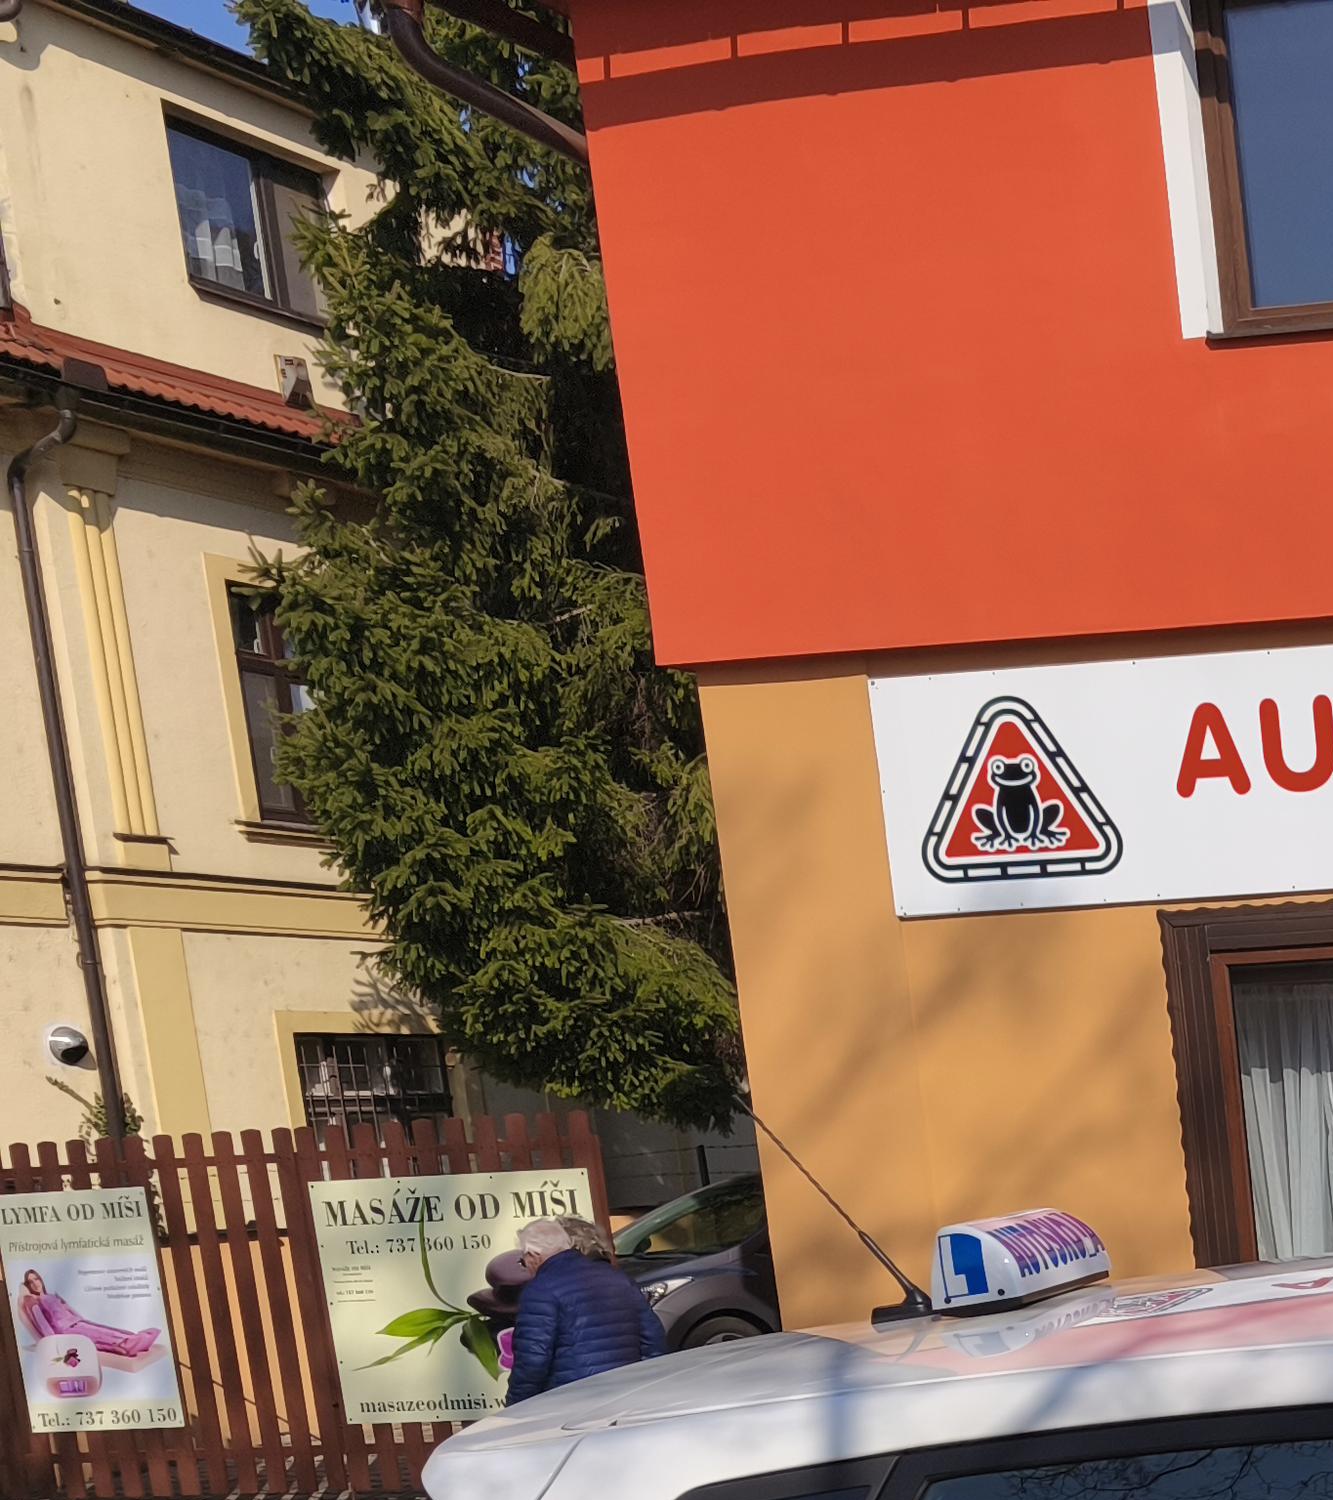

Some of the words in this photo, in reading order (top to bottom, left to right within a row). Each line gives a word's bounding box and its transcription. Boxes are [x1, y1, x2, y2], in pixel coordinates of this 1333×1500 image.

[1, 1205, 62, 1225] LYMFA
[66, 1203, 95, 1222] OD
[101, 1195, 144, 1220] MÍŠI
[321, 1187, 444, 1227] MASÁŽE
[454, 1193, 500, 1221] OD
[510, 1180, 581, 1219] MÍŠI
[346, 1240, 380, 1255] Tel.:
[386, 1238, 416, 1253] 737
[422, 1235, 454, 1252] 360
[461, 1233, 492, 1250] 150
[37, 1412, 70, 1428] Tel.:
[75, 1411, 105, 1426] 737
[111, 1409, 141, 1425] 360
[146, 1407, 177, 1423] 150
